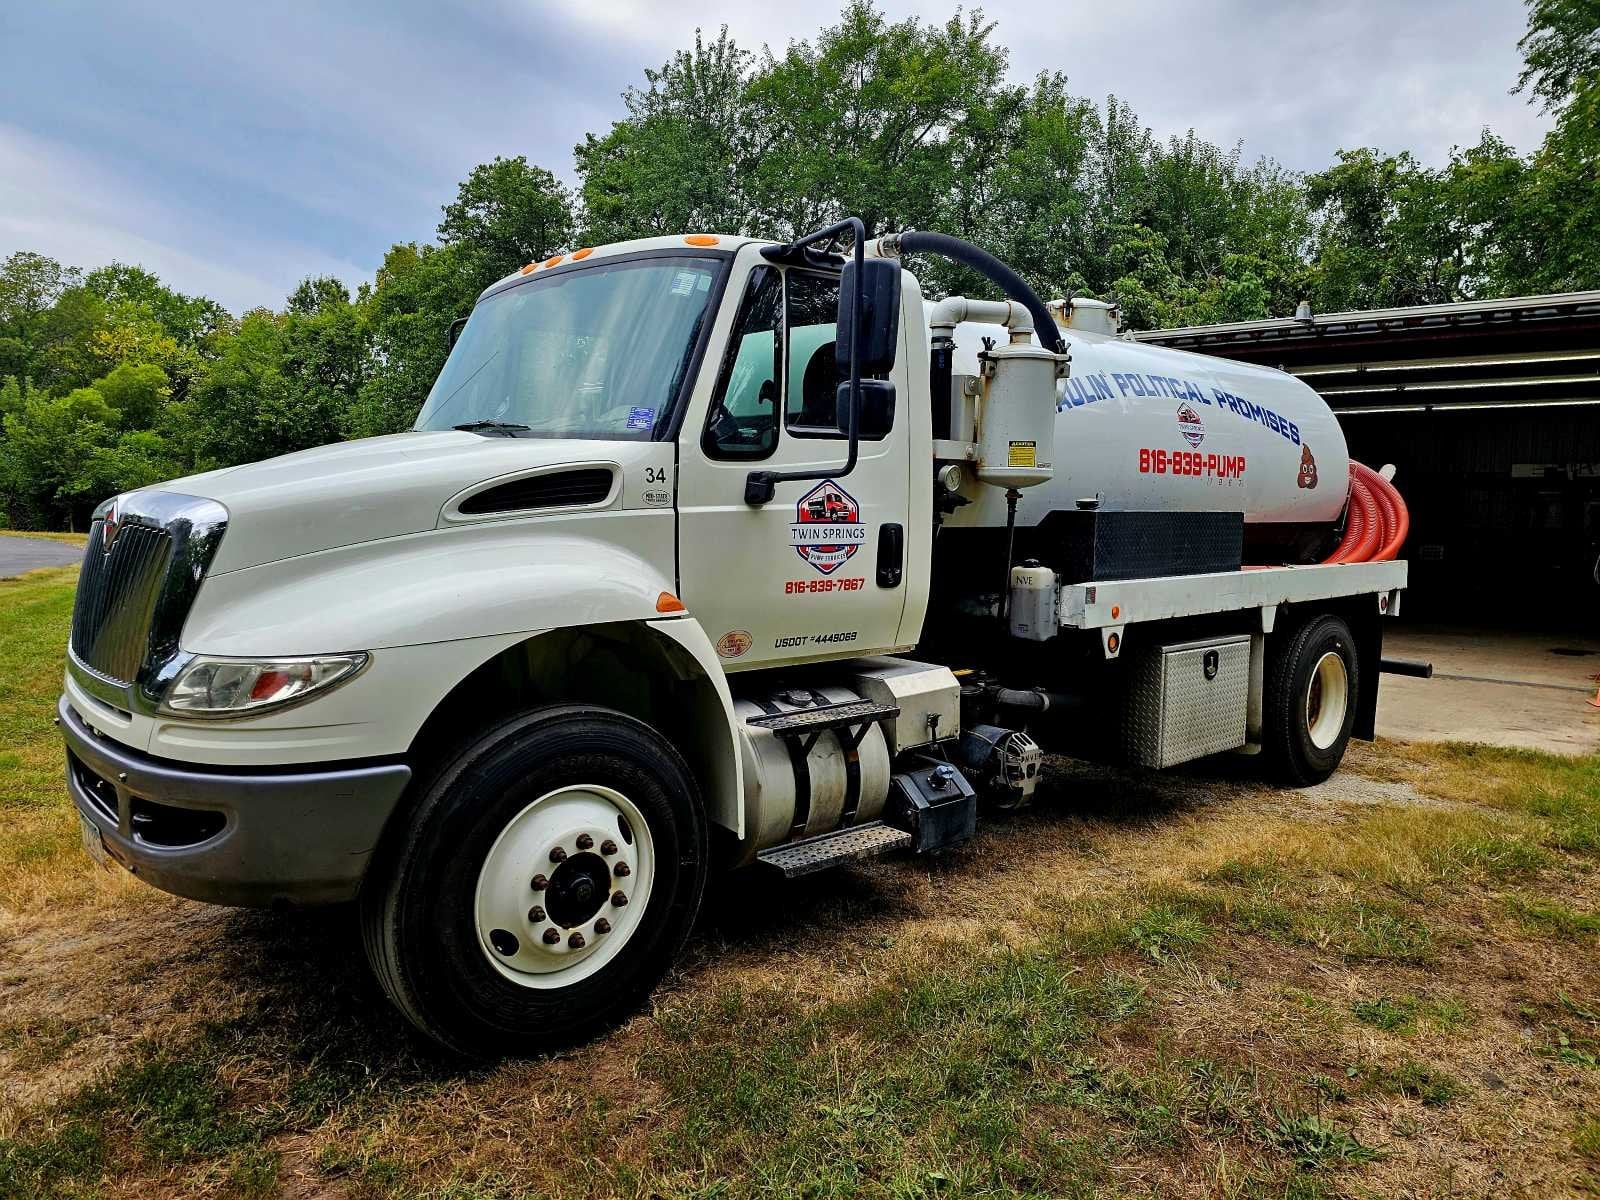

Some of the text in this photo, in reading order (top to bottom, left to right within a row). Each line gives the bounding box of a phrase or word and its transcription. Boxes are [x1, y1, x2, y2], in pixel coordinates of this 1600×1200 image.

[1056, 369, 1301, 446] AULIN' POLITICAL PROMISES
[1139, 448, 1246, 479] 816-839-PUMP
[645, 467, 666, 484] 34
[791, 528, 865, 539] TWIN SPRINGS
[784, 578, 865, 594] 816-839-7867
[1016, 575, 1033, 585] NVE
[774, 636, 809, 649] USDOT
